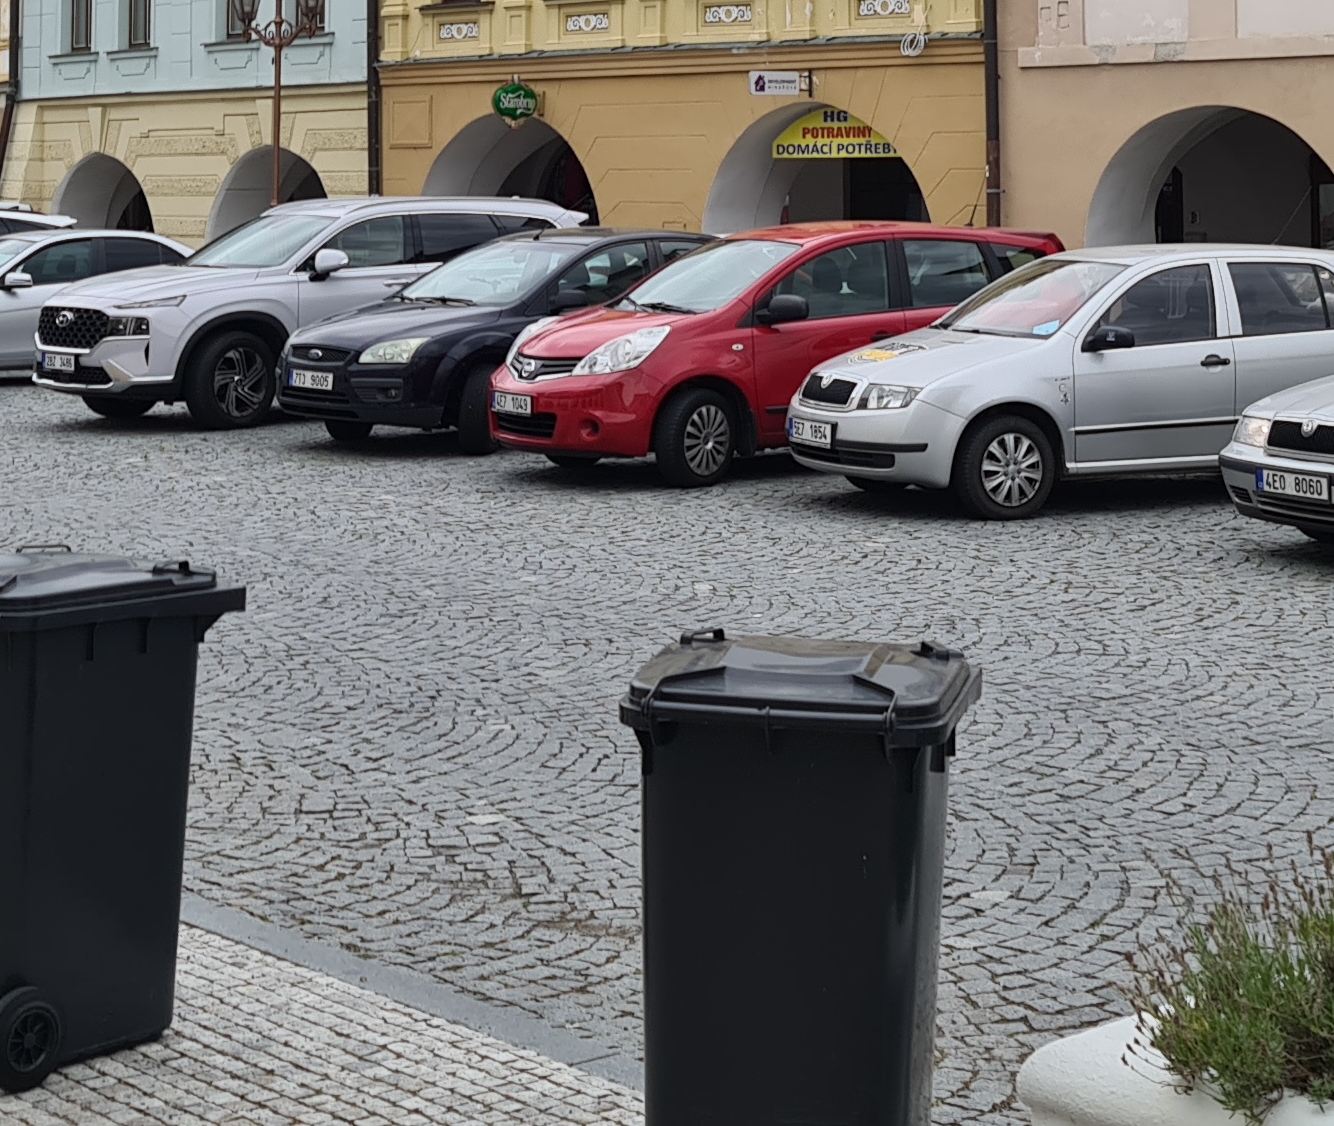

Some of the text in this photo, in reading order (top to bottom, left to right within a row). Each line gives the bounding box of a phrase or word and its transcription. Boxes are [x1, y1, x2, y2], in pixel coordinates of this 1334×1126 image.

[823, 110, 848, 123] HG
[802, 126, 873, 139] POTRAVINY
[776, 140, 833, 155] DOMÁCÍ
[1294, 477, 1323, 496] 8060
